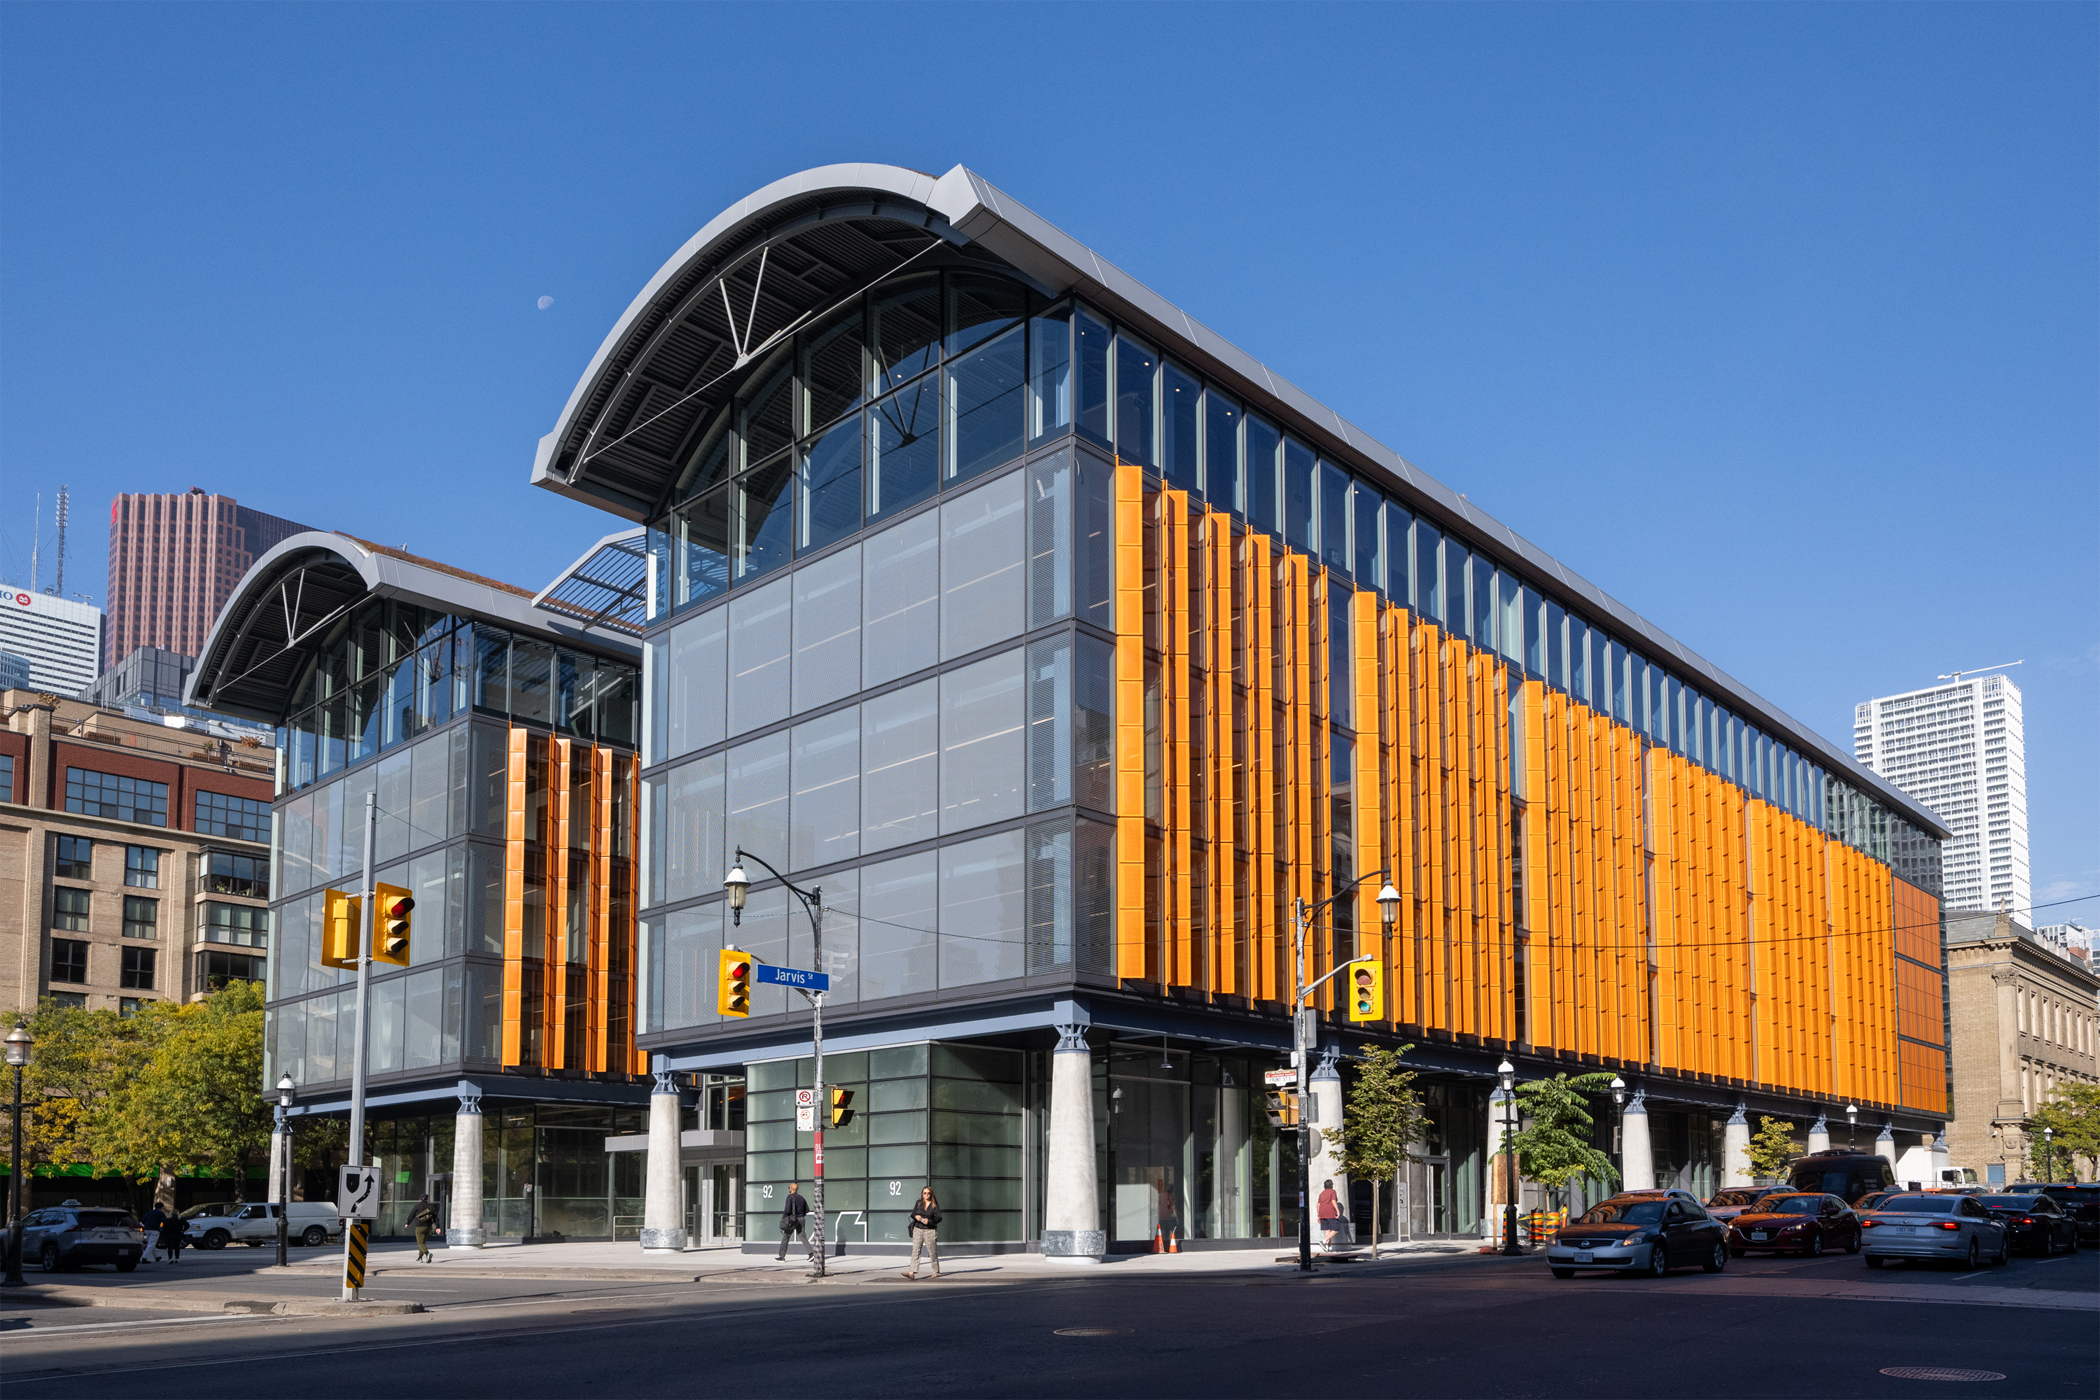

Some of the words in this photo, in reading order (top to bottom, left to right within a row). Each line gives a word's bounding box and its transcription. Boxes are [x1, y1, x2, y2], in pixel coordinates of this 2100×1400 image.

[775, 968, 805, 984] Jarvis
[762, 1185, 773, 1198] 92
[889, 1181, 901, 1196] 92
